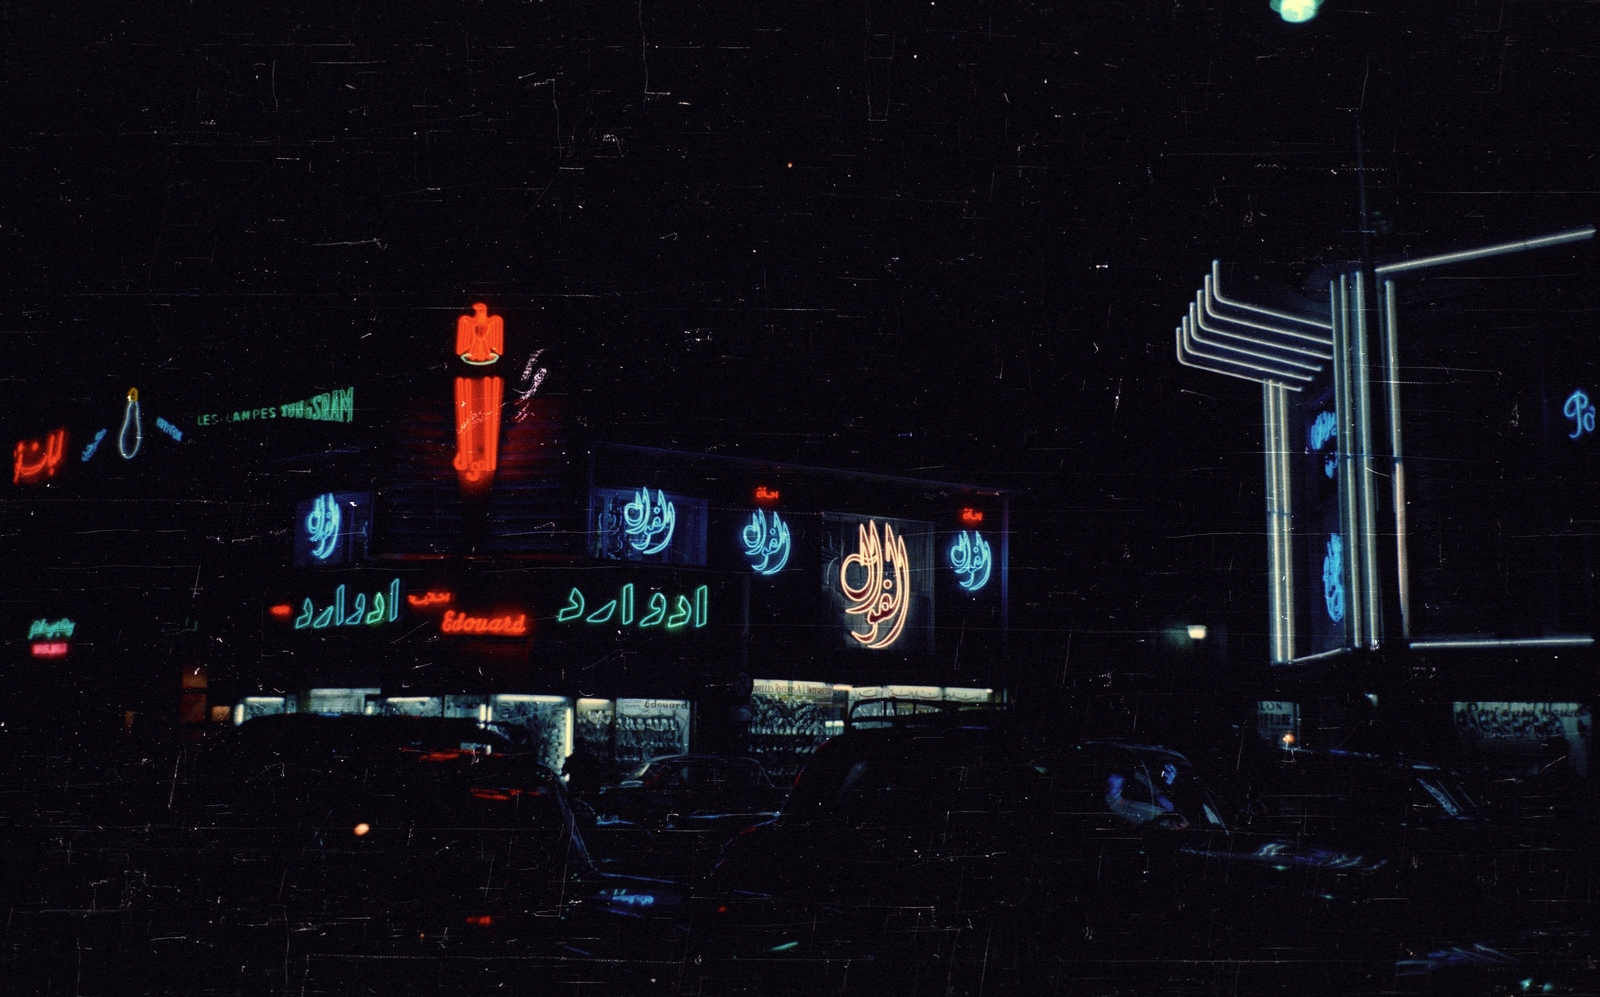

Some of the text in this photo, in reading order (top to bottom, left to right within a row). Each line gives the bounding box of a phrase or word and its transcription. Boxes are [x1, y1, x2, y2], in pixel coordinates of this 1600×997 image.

[198, 413, 218, 426] LES
[226, 407, 276, 422] LAMPES
[556, 582, 709, 629] ادوارد
[441, 609, 526, 634] Edouard
